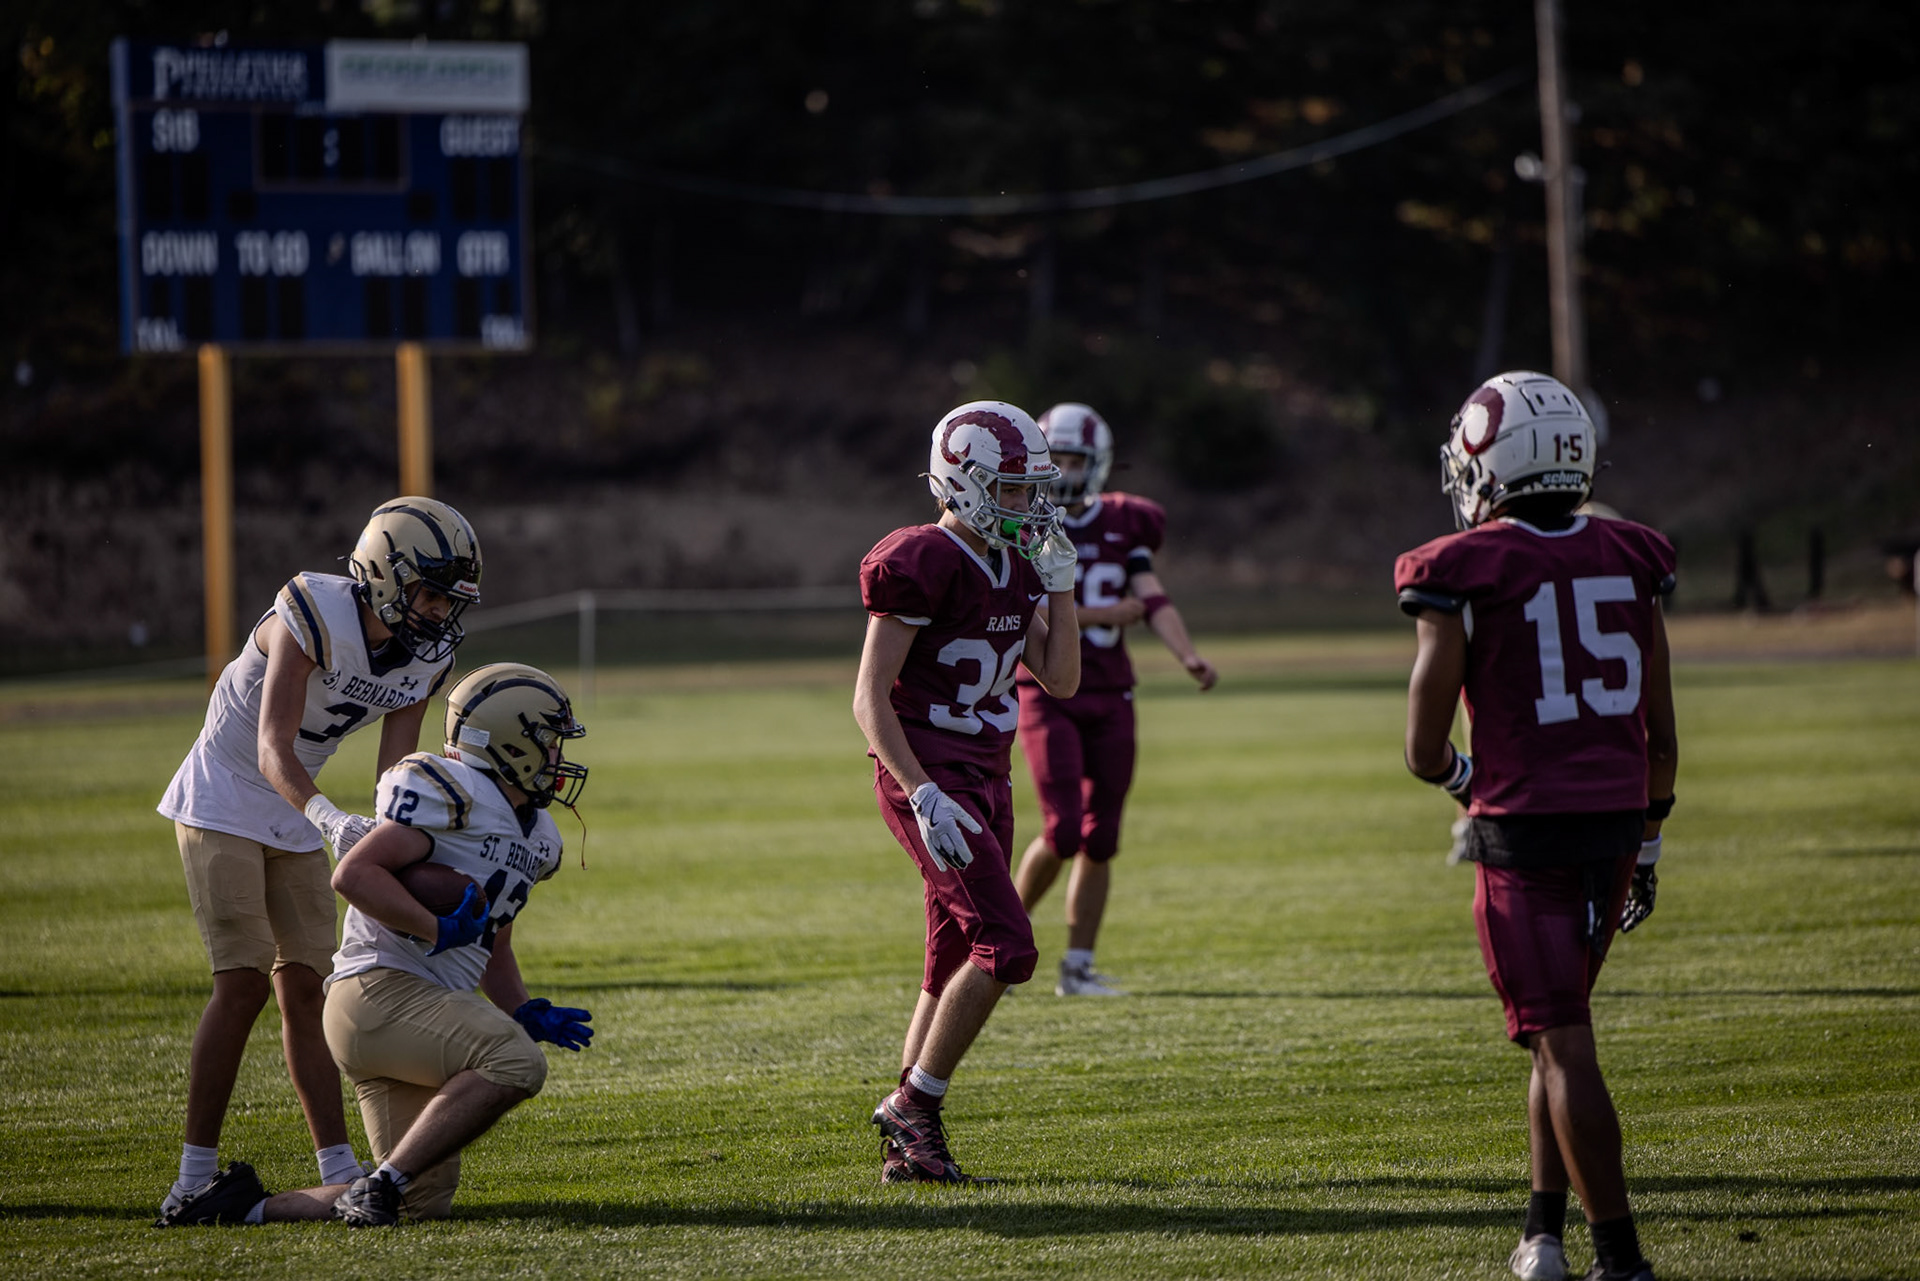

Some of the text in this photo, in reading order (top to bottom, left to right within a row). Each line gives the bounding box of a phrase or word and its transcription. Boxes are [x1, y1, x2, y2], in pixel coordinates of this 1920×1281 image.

[142, 230, 218, 276] DOWN
[985, 614, 1022, 632] RAMS
[1523, 575, 1643, 726] 15
[385, 785, 420, 827] 12
[480, 835, 500, 862] ST.
